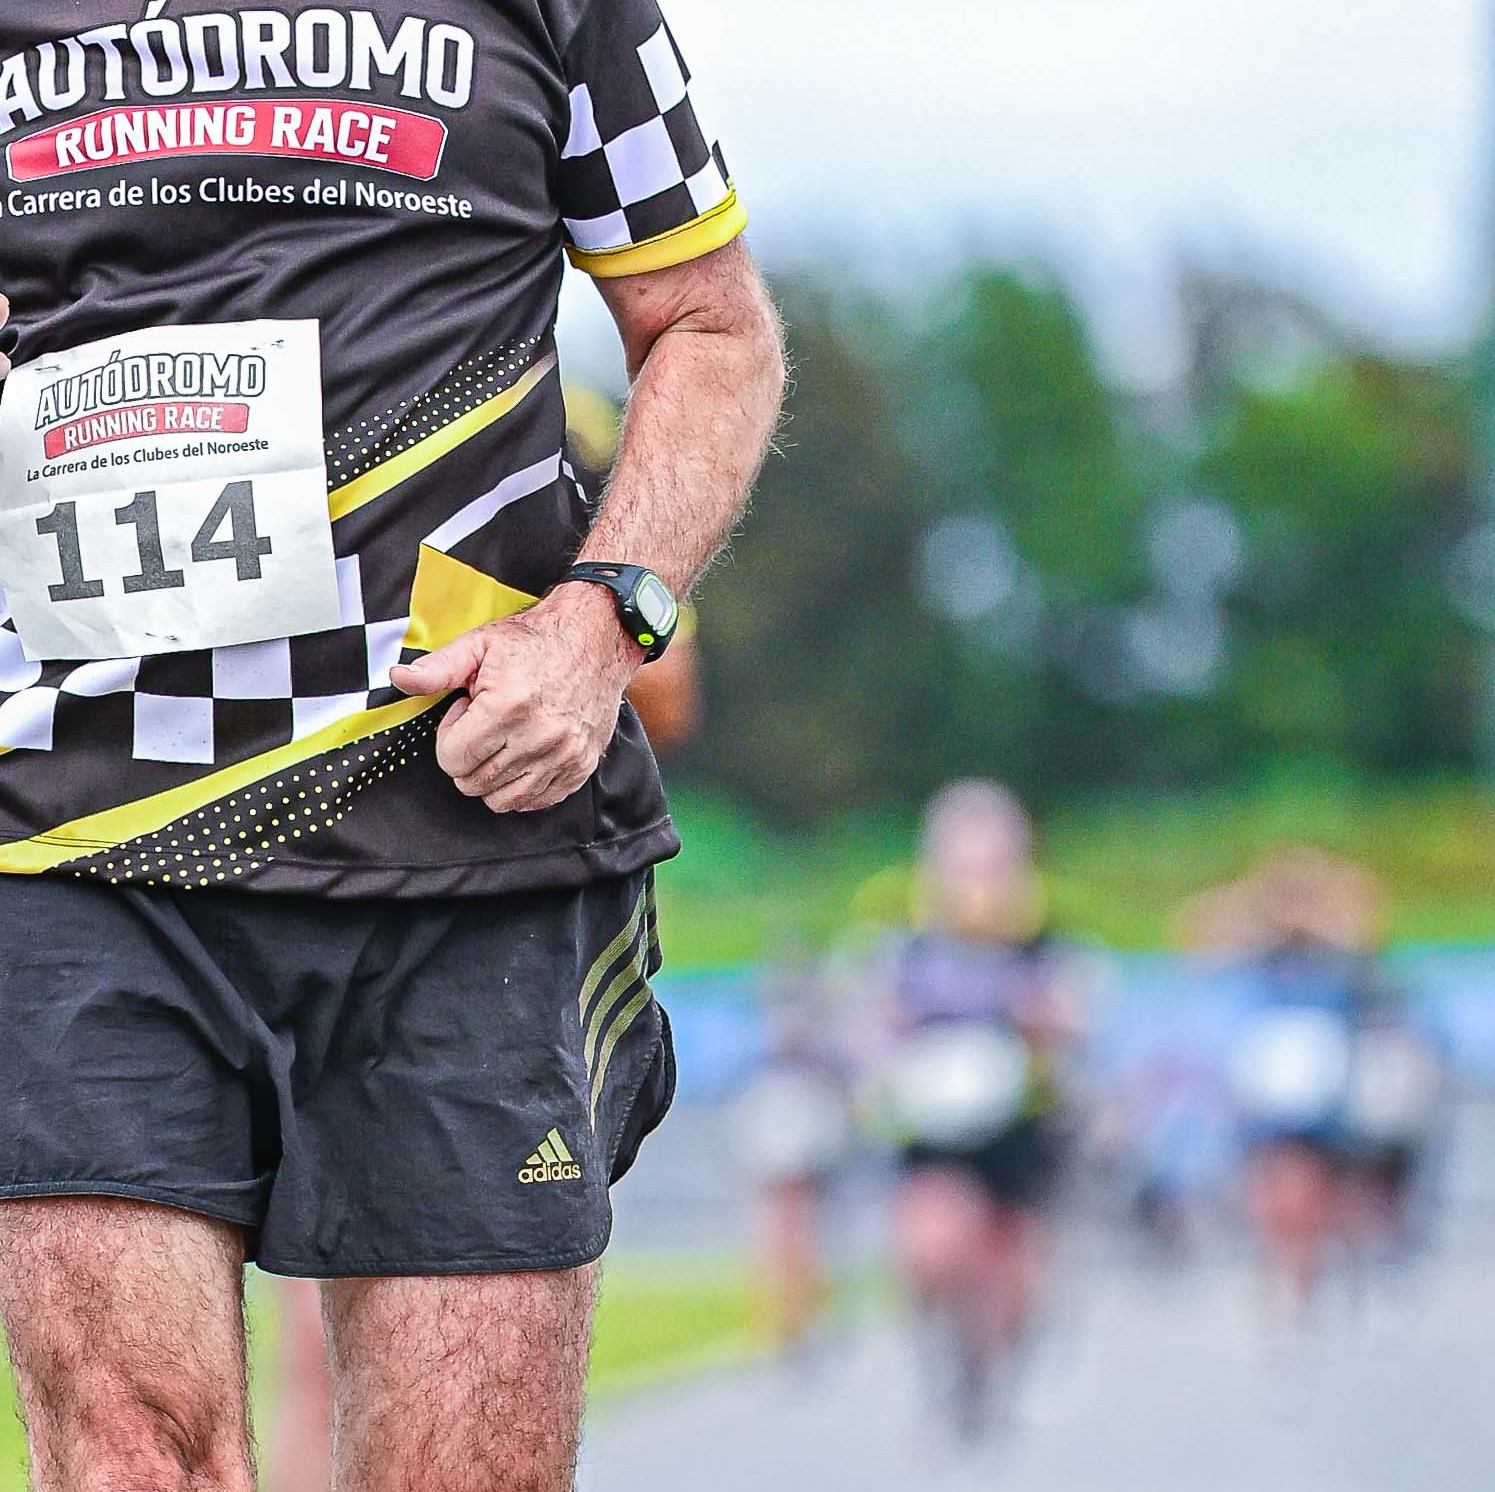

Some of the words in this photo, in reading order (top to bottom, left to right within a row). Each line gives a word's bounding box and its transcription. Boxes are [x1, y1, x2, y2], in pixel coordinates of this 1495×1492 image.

[55, 105, 257, 169] RUNNING
[270, 106, 398, 164] RACE
[7, 189, 101, 218] Carrera
[108, 179, 144, 207] de
[151, 179, 191, 205] los
[199, 177, 296, 205] Clubes
[302, 179, 347, 206] del
[354, 181, 473, 219] Noroeste
[34, 349, 266, 430] AUTÓDROMO
[63, 408, 156, 451] RUNNING
[163, 406, 223, 431] RACE
[26, 469, 40, 483] La
[42, 461, 88, 479] Carrera
[90, 454, 108, 470] de
[110, 452, 130, 467] los
[133, 446, 180, 463] Clubes
[182, 442, 204, 458] del
[206, 438, 270, 456] Noroeste
[35, 480, 273, 603] 114
[517, 1162, 582, 1184] adidas
